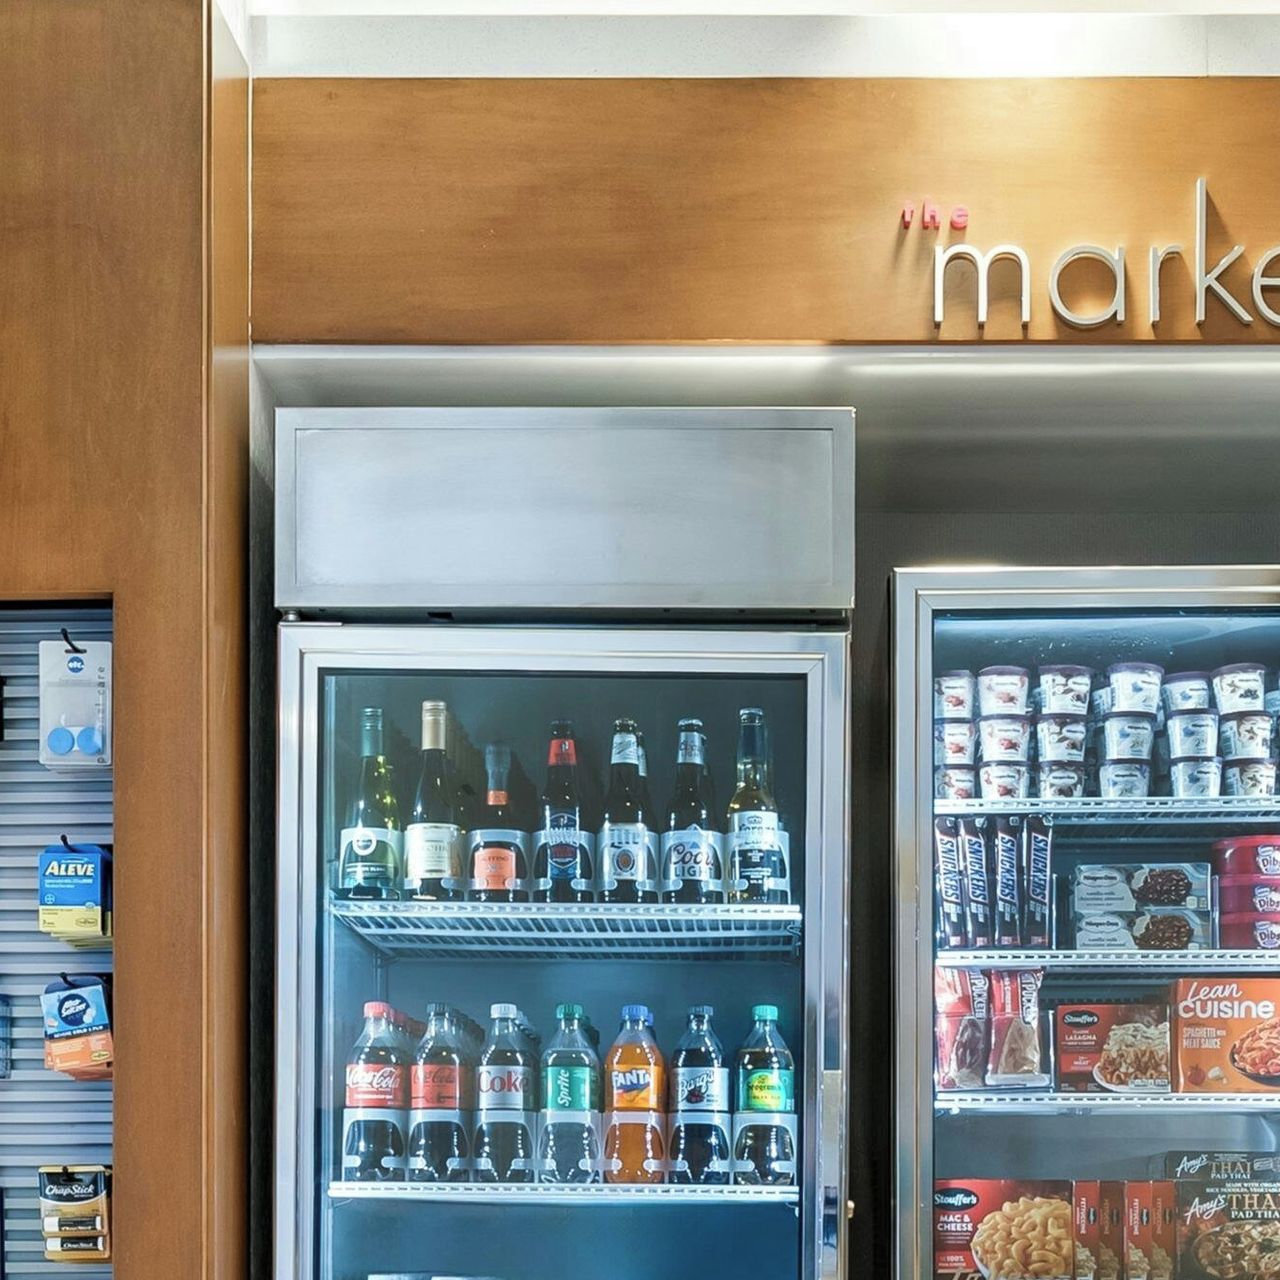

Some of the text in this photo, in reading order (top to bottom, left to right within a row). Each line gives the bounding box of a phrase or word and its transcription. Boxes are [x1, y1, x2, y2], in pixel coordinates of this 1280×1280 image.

[45, 861, 95, 877] ALEVE
[940, 838, 960, 901] SNICKERS
[968, 838, 988, 901] SNICKERS
[1000, 836, 1017, 901] SNICKERS
[1031, 835, 1048, 901] SNICKERS
[1258, 898, 1280, 909] Dibs
[1258, 930, 1280, 941] Dibs
[1188, 981, 1243, 1001] Lean
[1201, 1038, 1221, 1049] SAUCE
[479, 1071, 529, 1093] Coke
[558, 1069, 570, 1107] Sprite
[1176, 1154, 1251, 1177] Amy's THAI
[45, 1184, 94, 1196] ChapStick
[934, 1193, 977, 1206] Stouffer's
[1184, 1194, 1228, 1225] Amy's
[1231, 1211, 1254, 1219] PAD
[937, 1223, 973, 1232] CHEESE
